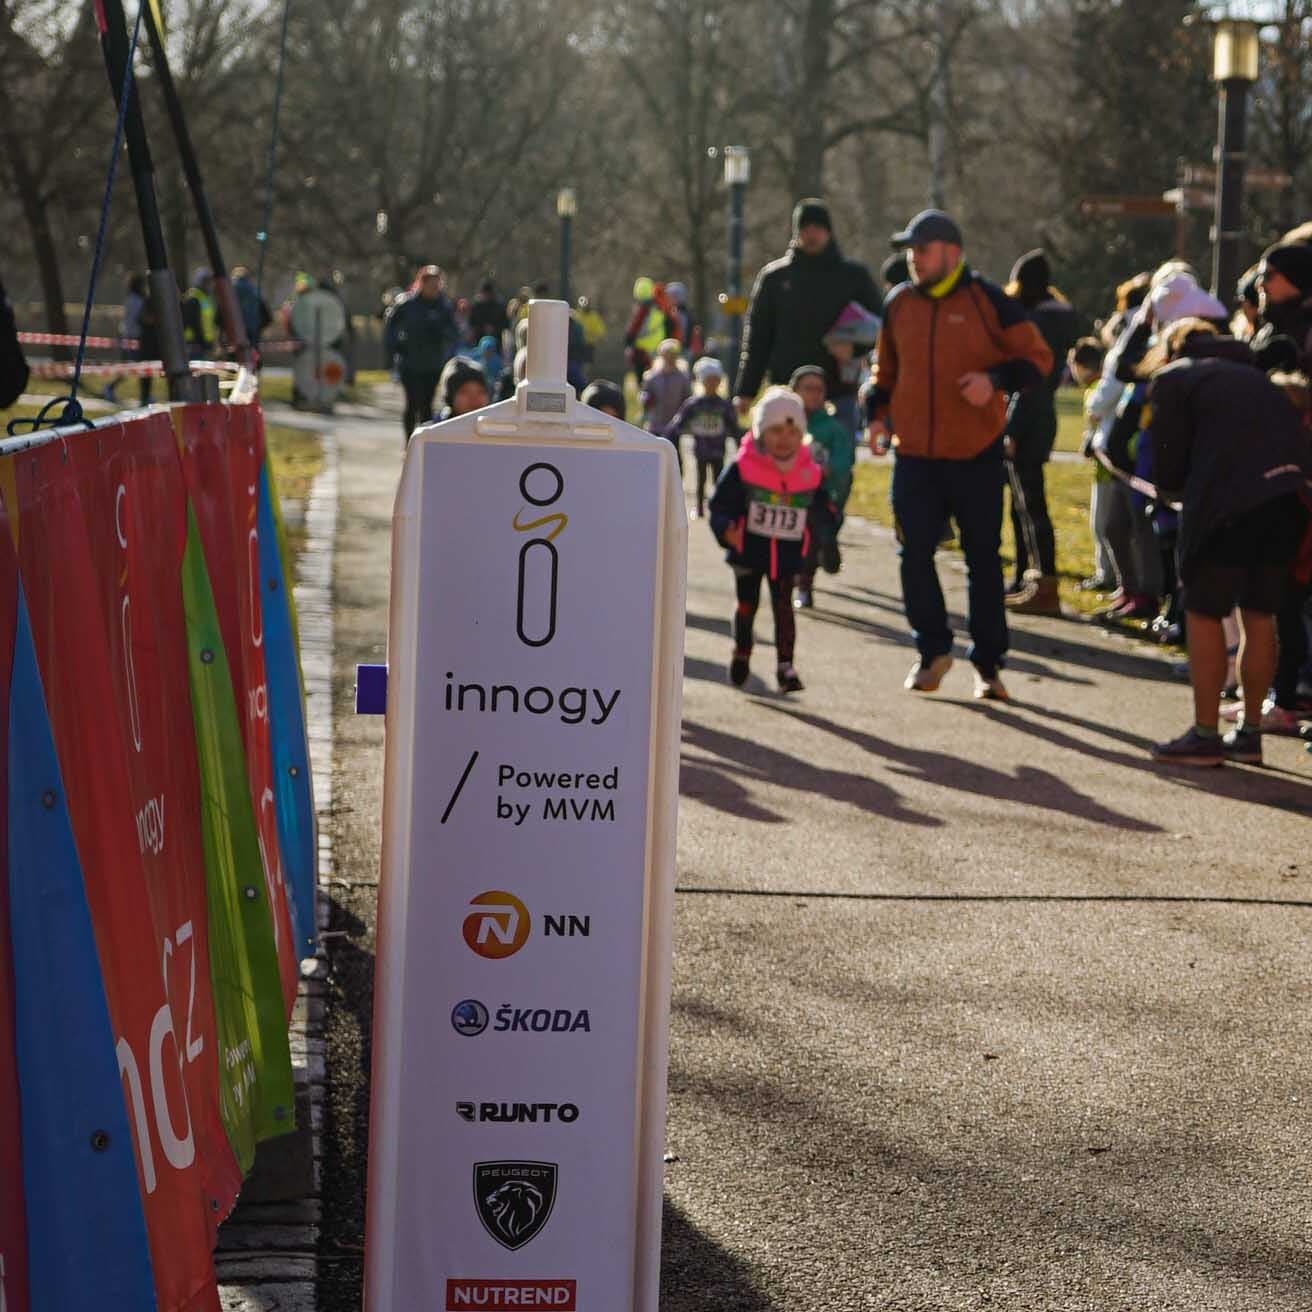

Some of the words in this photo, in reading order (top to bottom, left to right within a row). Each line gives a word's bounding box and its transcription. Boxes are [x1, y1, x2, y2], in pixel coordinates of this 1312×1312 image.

[445, 672, 621, 725] innogy
[498, 765, 619, 790] Powered
[496, 795, 531, 826] by
[543, 799, 616, 822] MVM
[543, 914, 591, 937] NN
[493, 1003, 591, 1033] ŠKODA
[479, 1102, 580, 1123] RUNTO
[481, 1167, 550, 1178] PEUGEOT
[453, 1286, 570, 1305] NUTREND
